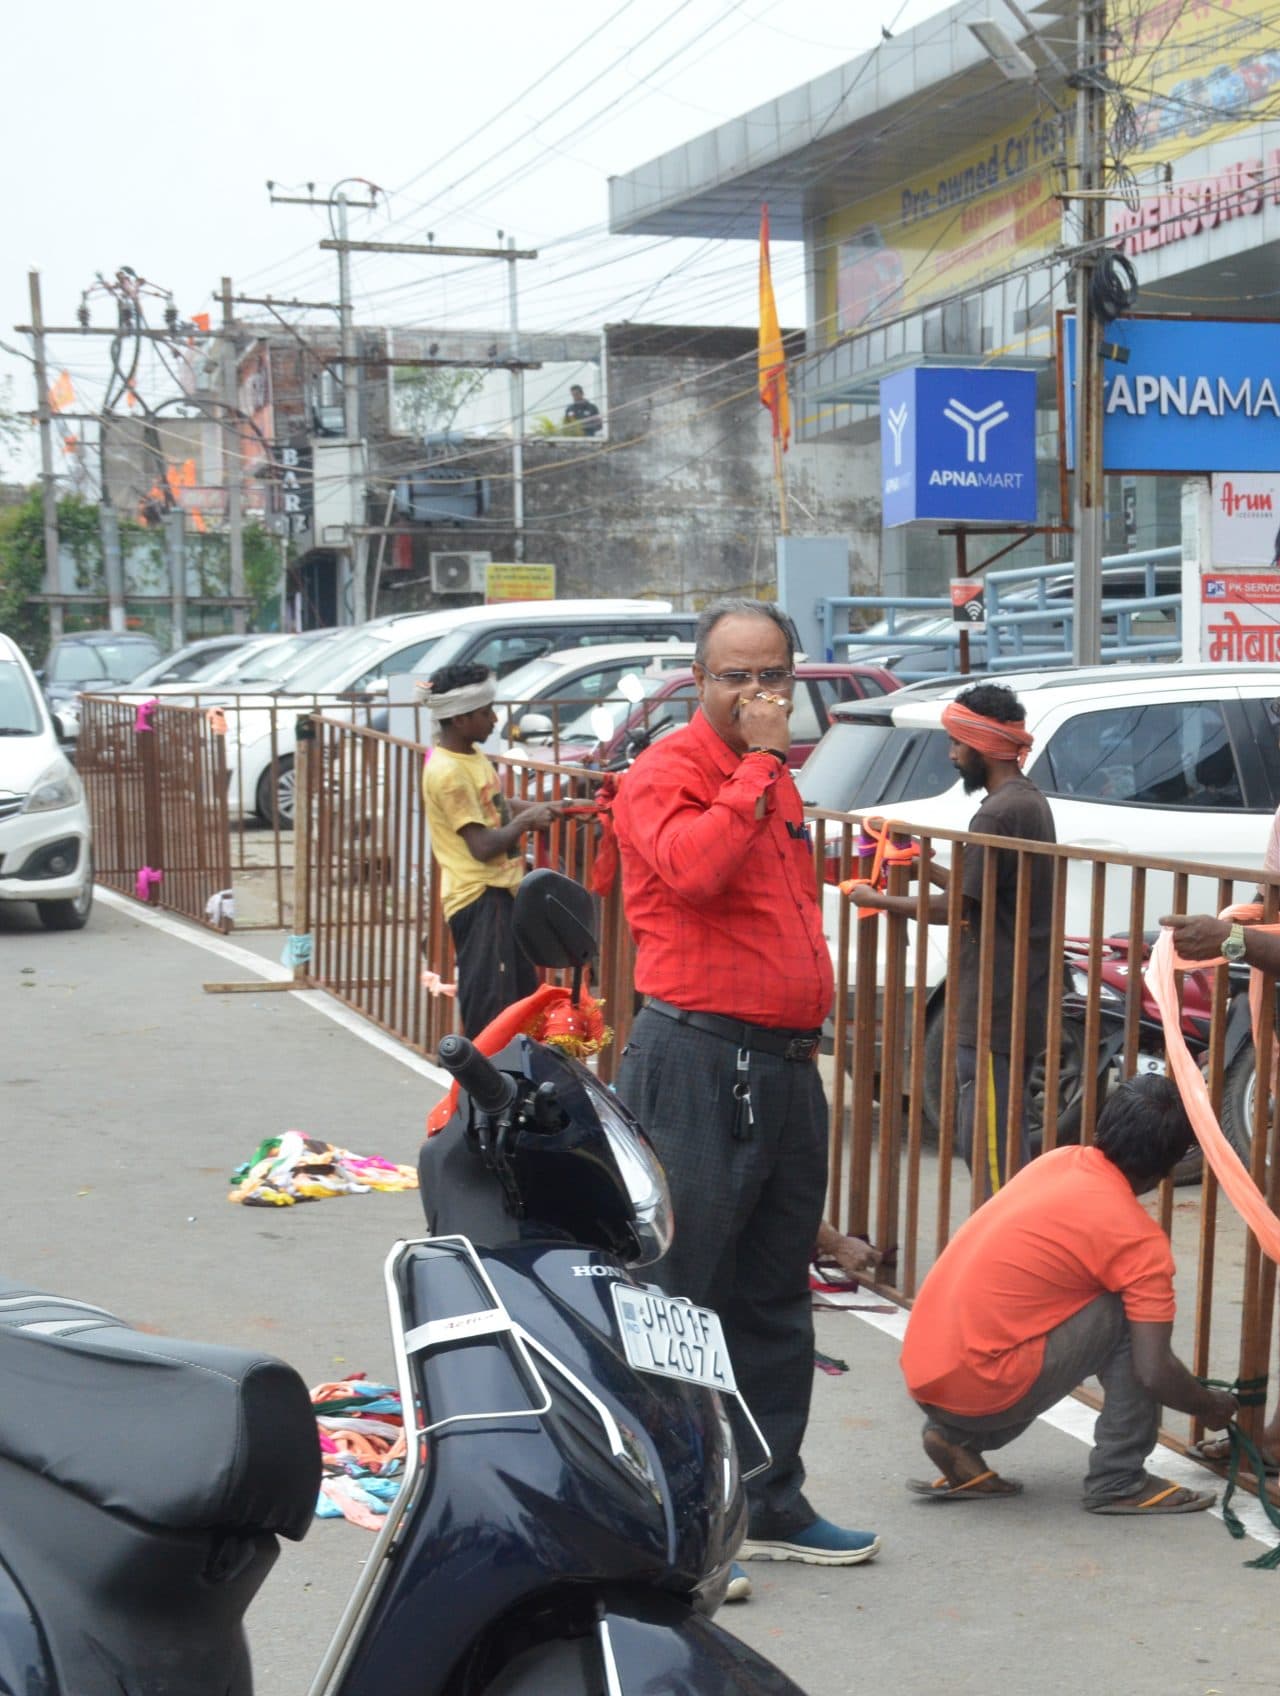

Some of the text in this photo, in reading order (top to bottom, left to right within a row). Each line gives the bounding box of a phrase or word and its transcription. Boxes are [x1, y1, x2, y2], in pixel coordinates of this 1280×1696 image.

[1111, 160, 1263, 256] PREMSONS
[928, 469, 1024, 488] APNAMART
[1220, 481, 1272, 517] Arun
[1206, 581, 1225, 596] PK
[642, 1297, 709, 1345] JH01F
